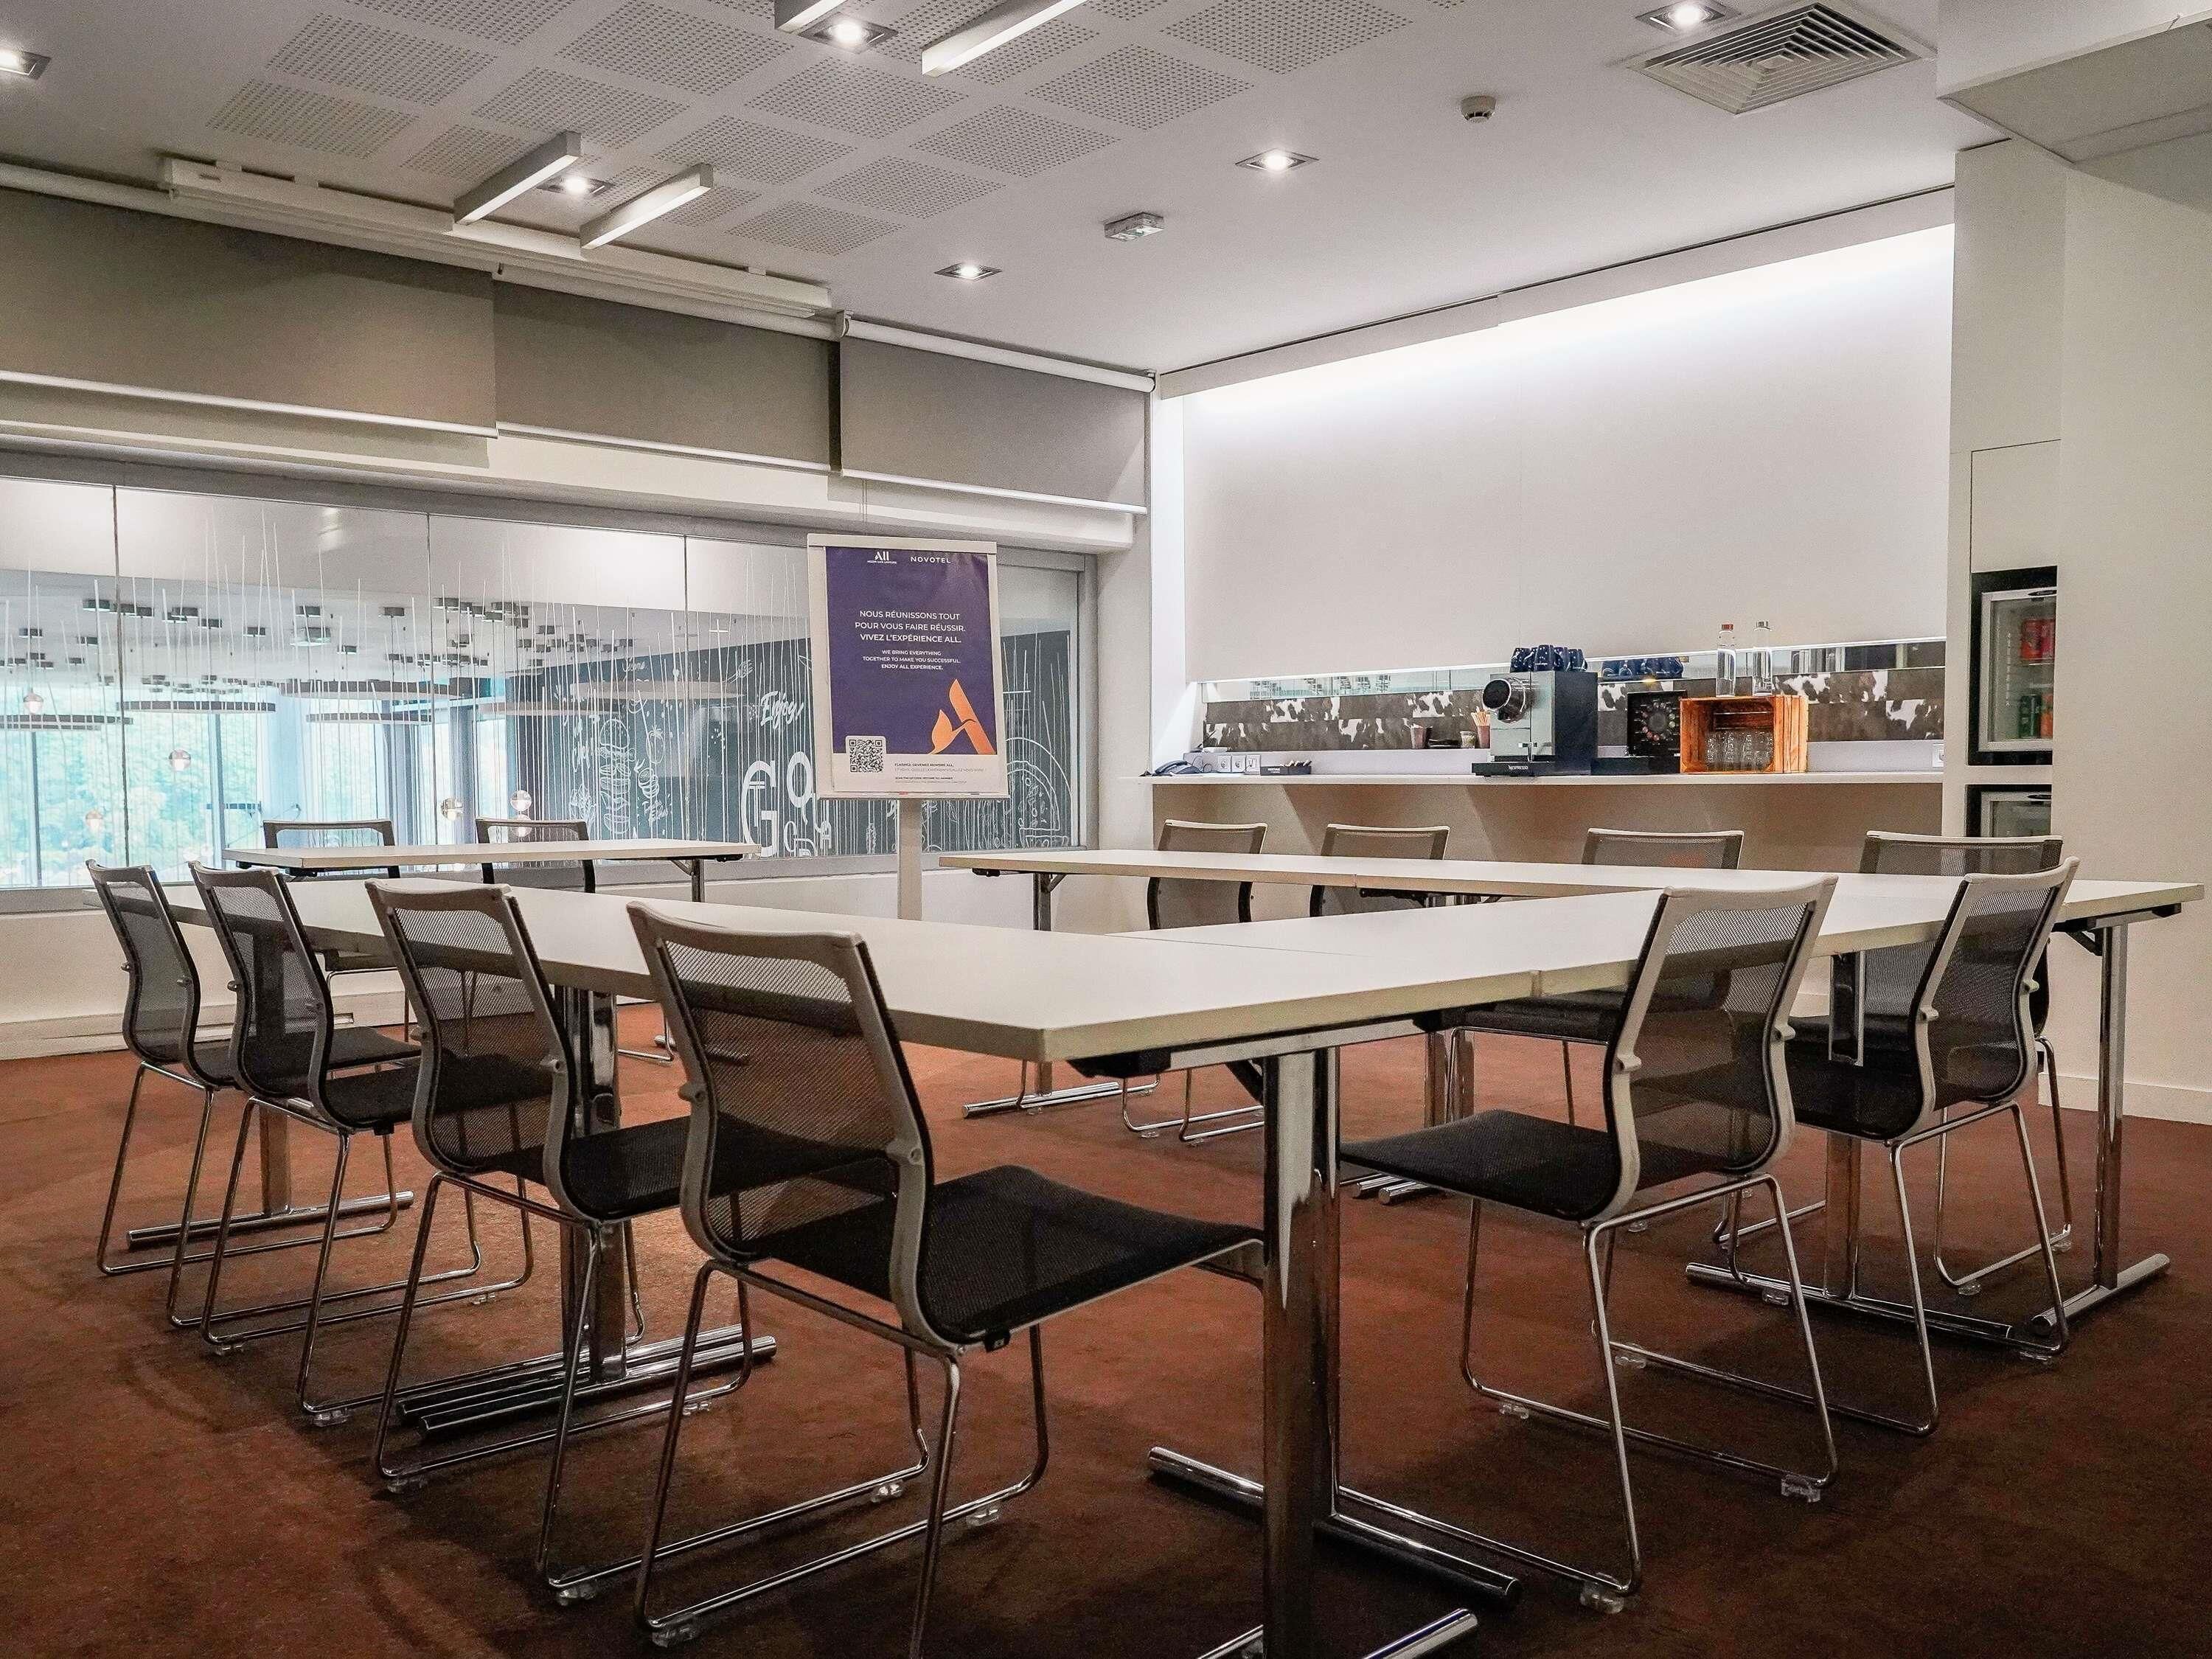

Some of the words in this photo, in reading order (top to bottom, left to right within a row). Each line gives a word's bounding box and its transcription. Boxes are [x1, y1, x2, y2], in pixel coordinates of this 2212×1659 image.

[910, 556, 951, 564] NOVOTEL
[885, 610, 937, 619] RÉUNISSONS
[931, 623, 966, 632] RÉUSSIR.
[886, 633, 943, 643] L'EXPÉRIENCE
